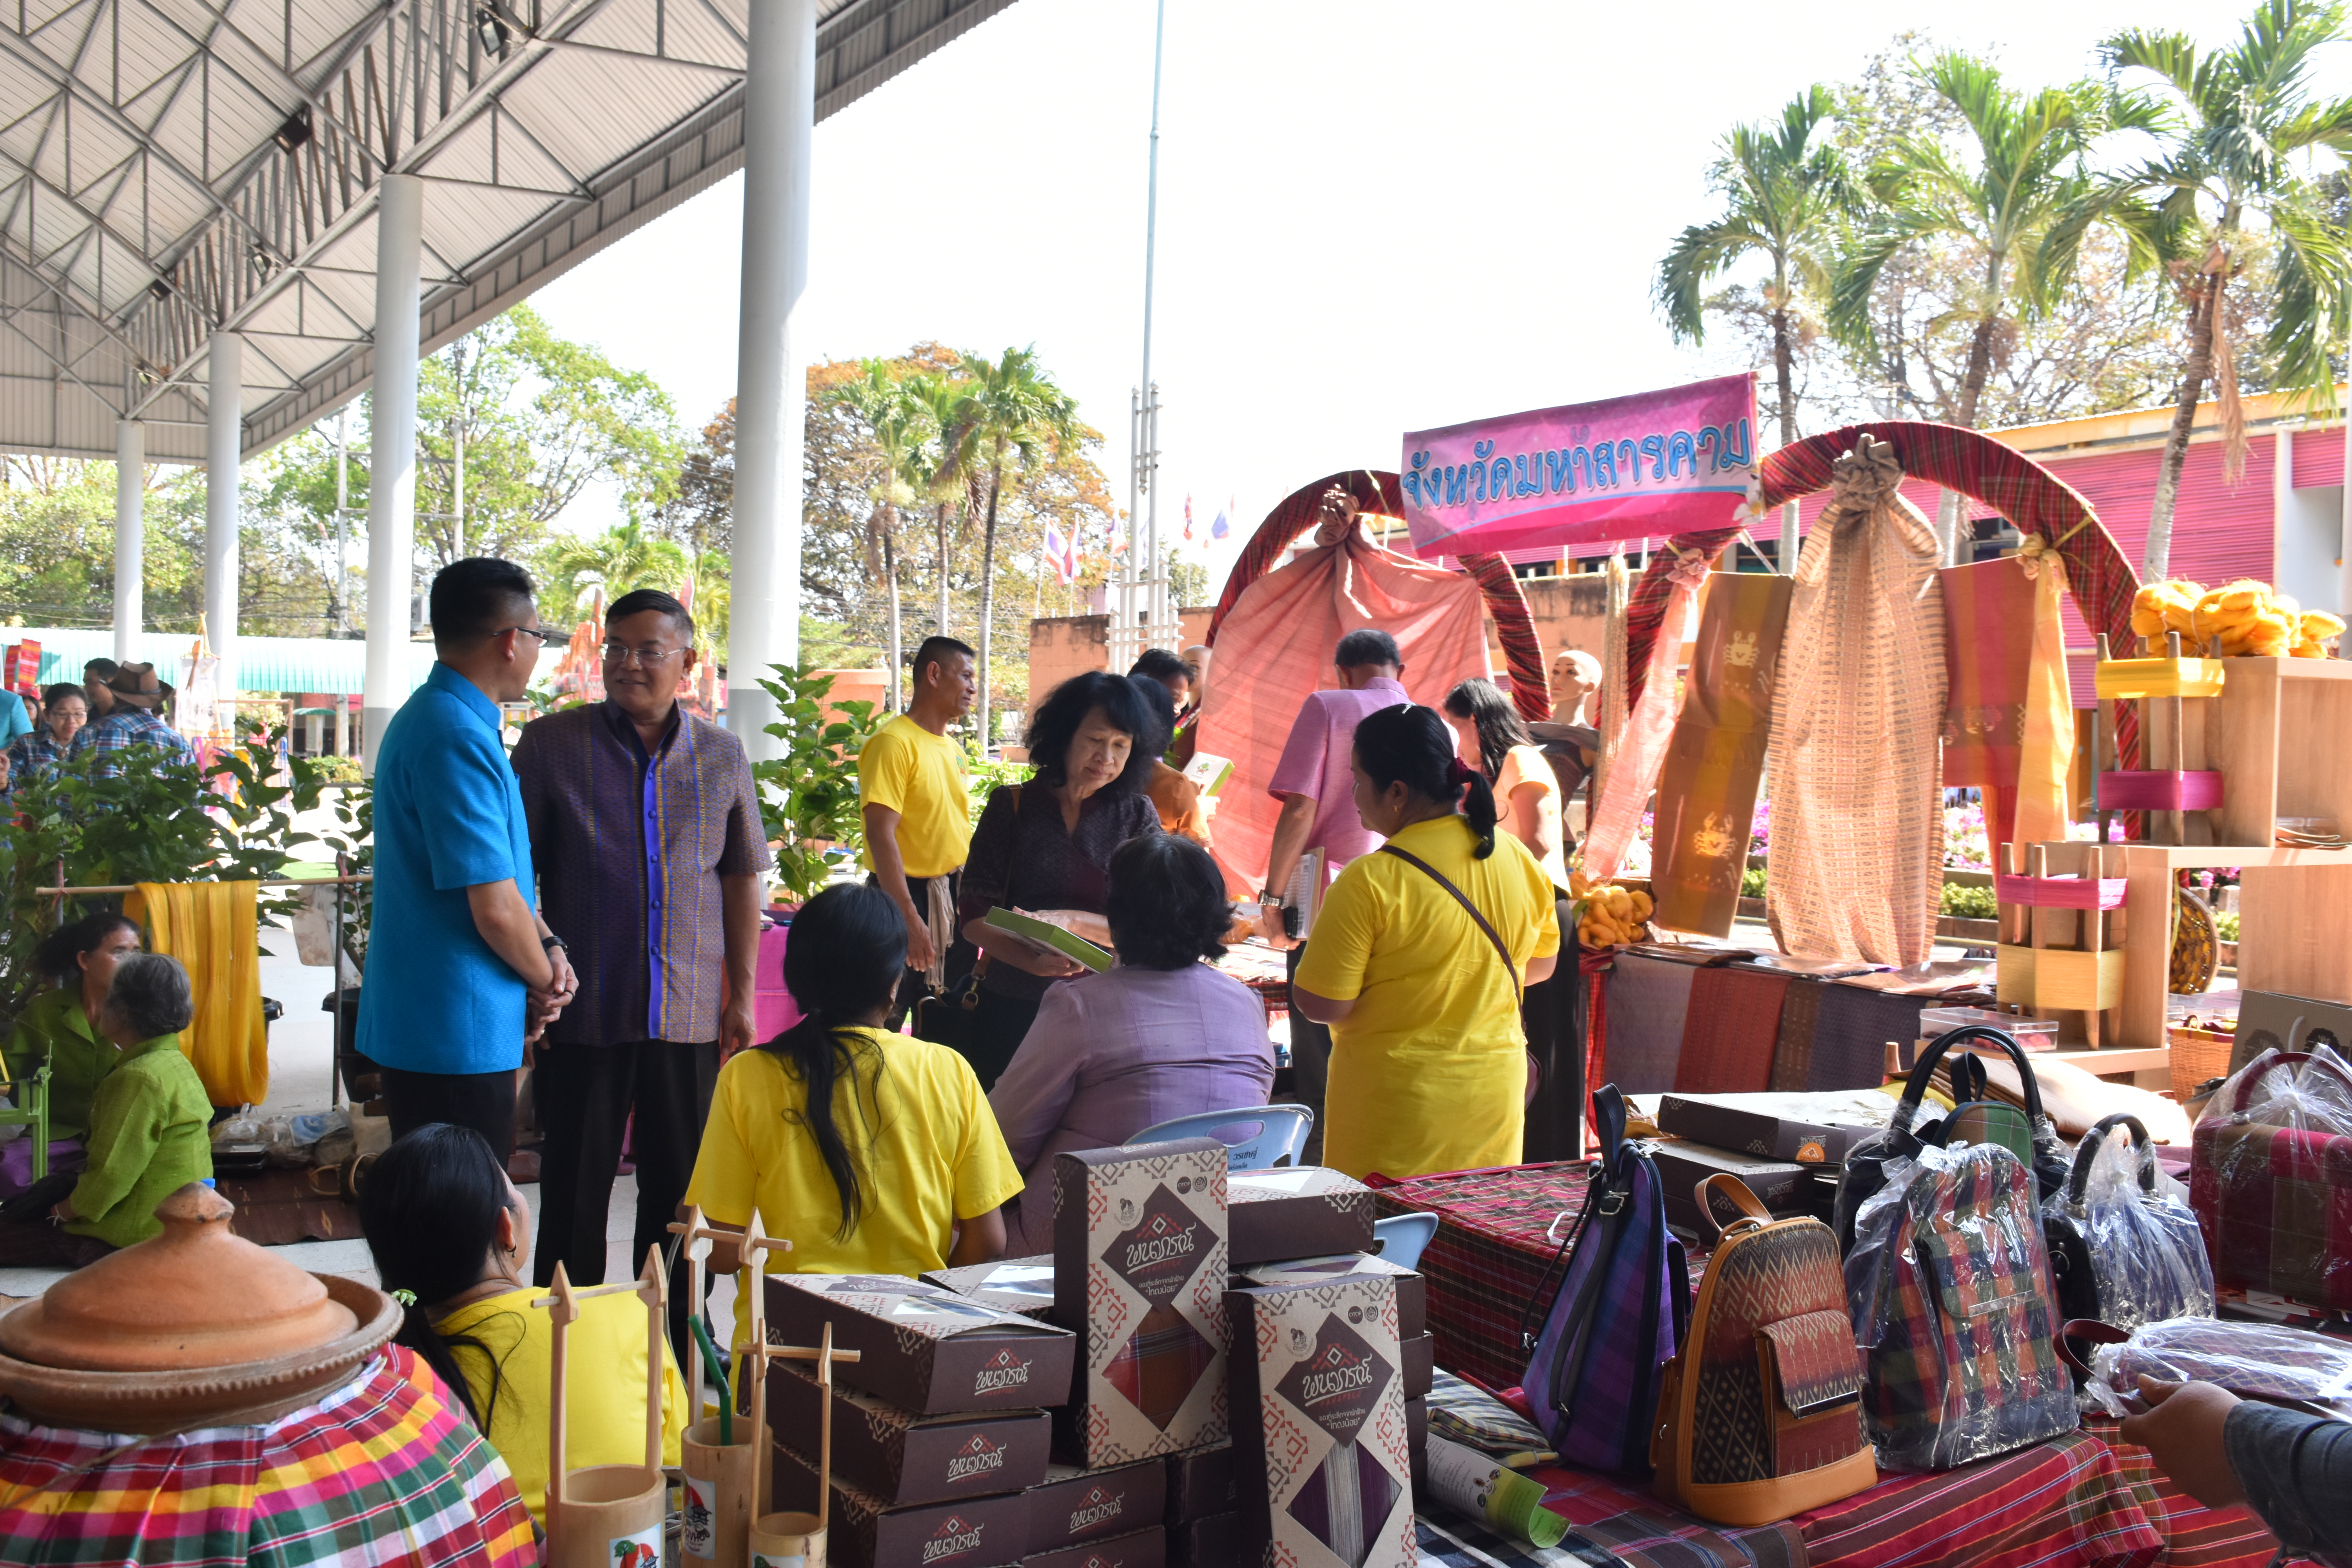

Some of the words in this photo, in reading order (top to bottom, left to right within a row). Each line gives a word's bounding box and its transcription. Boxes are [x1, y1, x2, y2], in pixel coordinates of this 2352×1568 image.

[1403, 417, 1751, 510] จังหวัดมหาสารคาม
